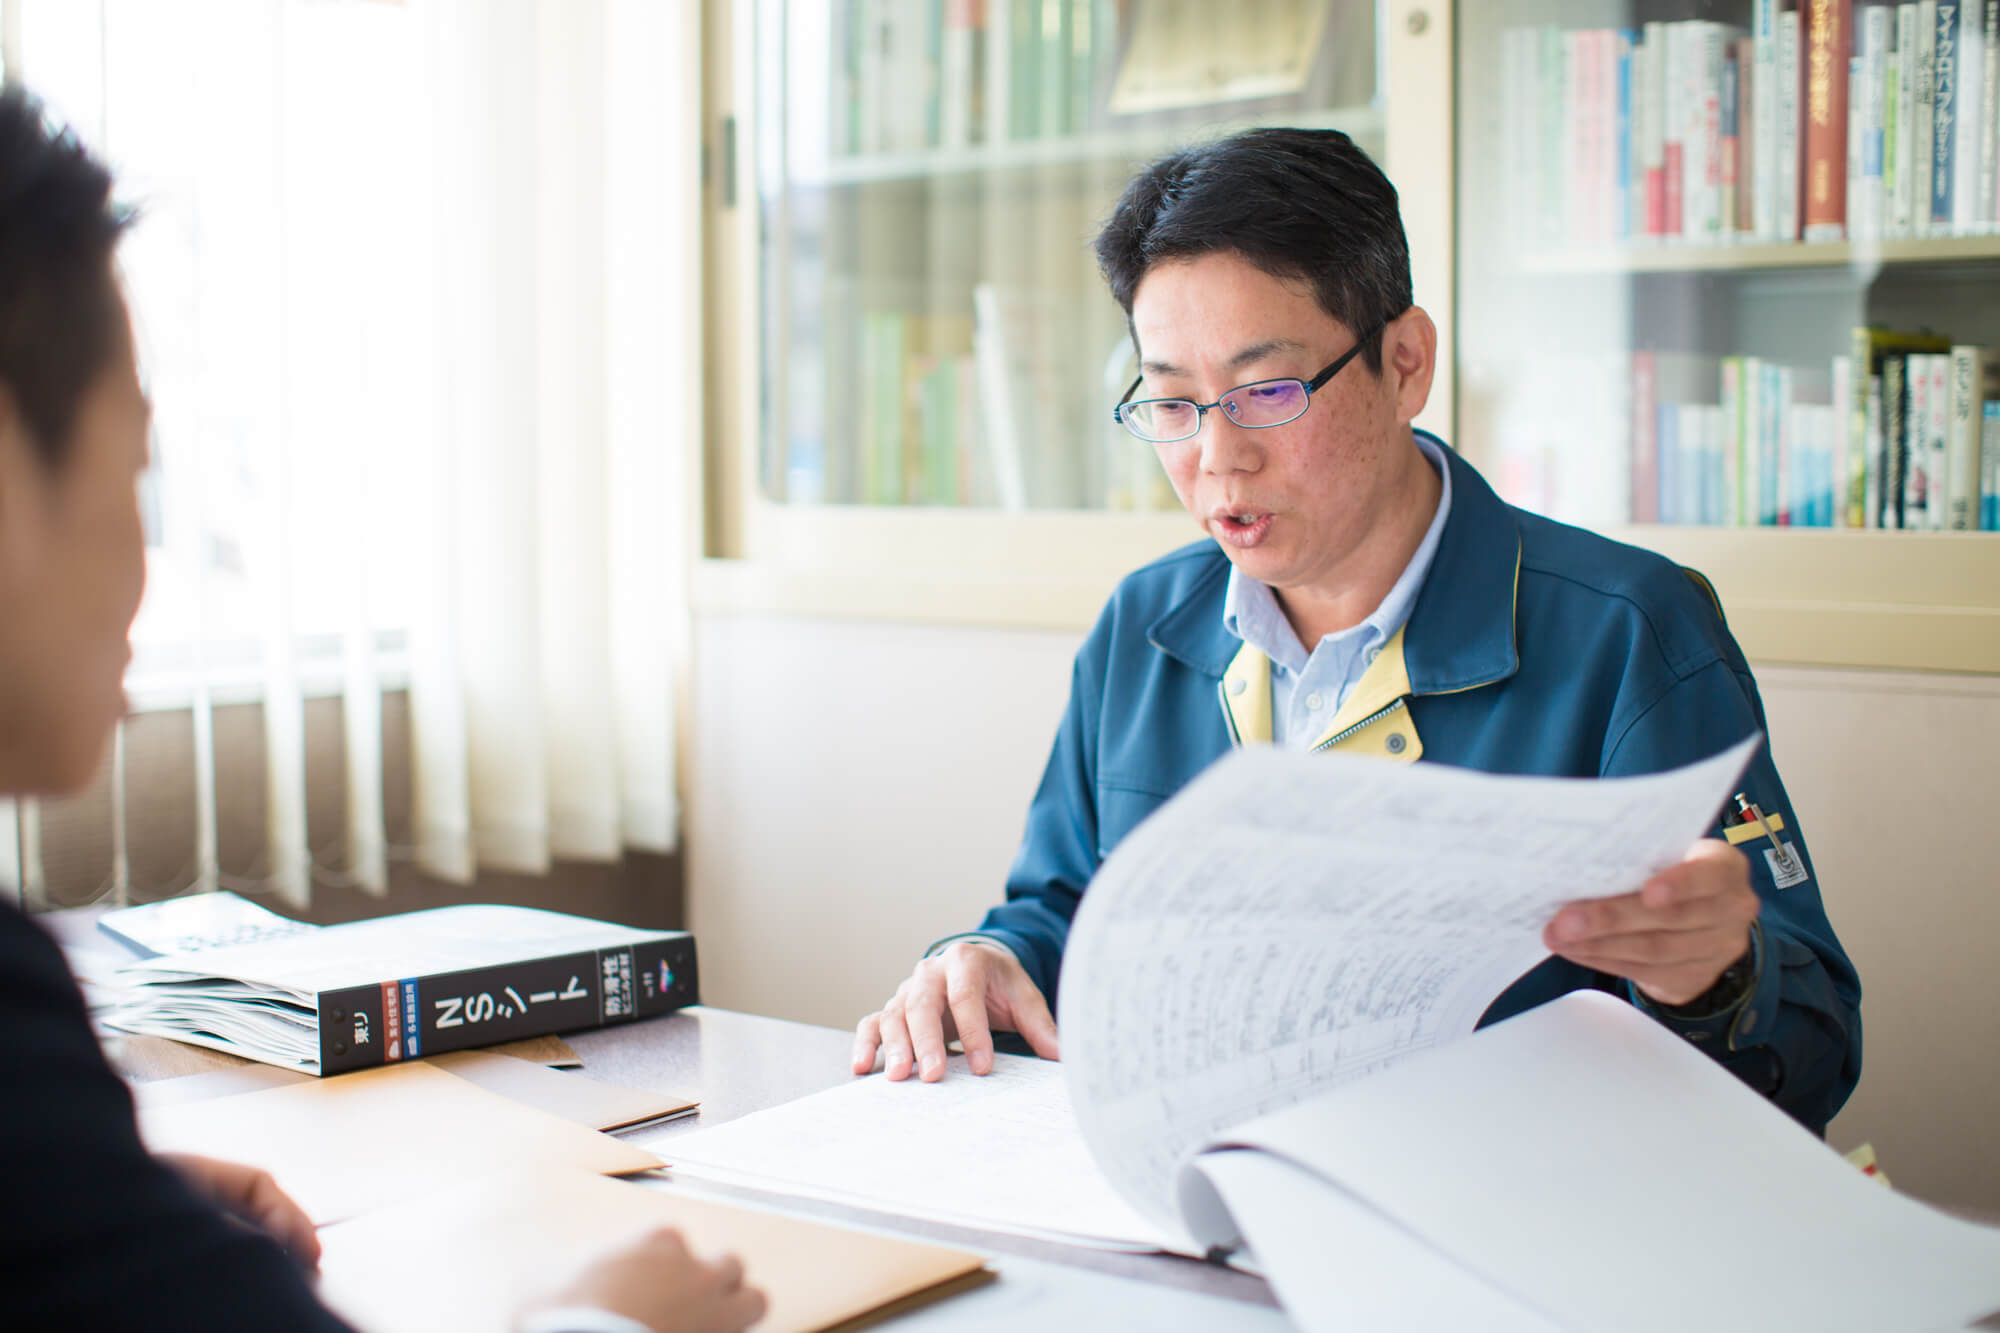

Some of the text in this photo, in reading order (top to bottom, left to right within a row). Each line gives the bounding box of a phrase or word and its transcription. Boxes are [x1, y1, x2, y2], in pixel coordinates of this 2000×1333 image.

[435, 975, 588, 1030] NSシート
[354, 1011, 369, 1045] 東リ
